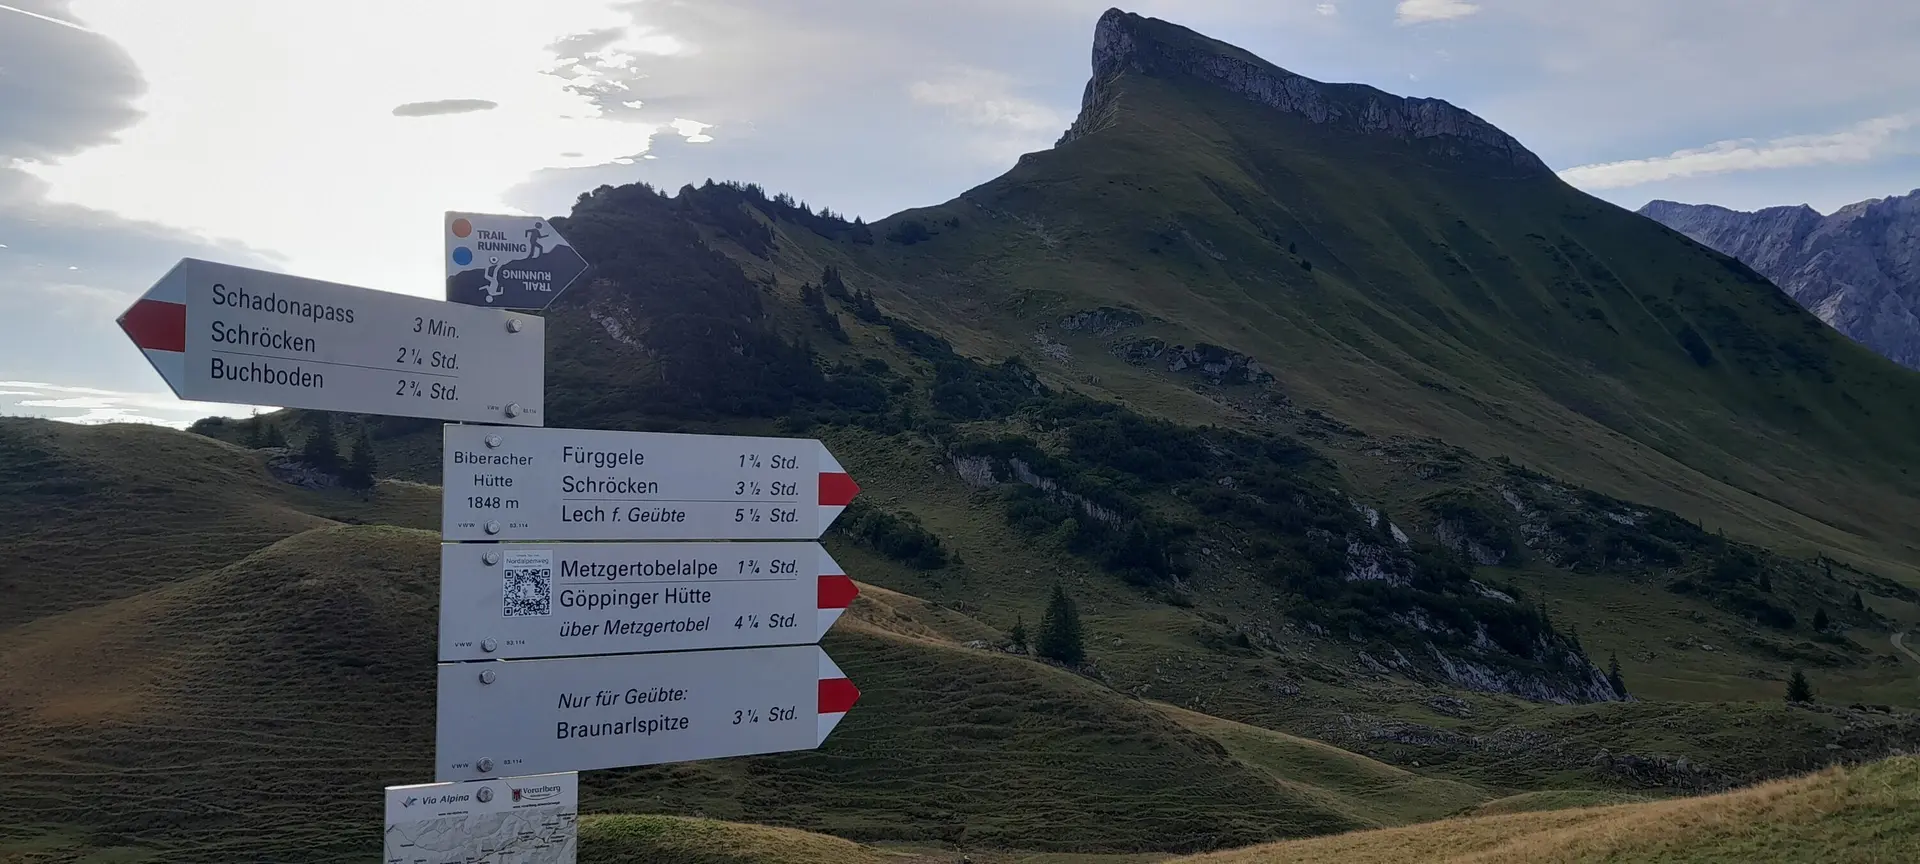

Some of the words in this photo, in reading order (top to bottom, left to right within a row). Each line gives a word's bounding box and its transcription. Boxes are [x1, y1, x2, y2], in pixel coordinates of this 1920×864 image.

[477, 230, 507, 241] TRAIL
[477, 242, 527, 253] RUNNING
[503, 269, 551, 281] RUNNING
[522, 281, 551, 292] TRAIL
[211, 283, 355, 325] Schadonapass
[413, 317, 425, 333] 3
[427, 318, 460, 339] Min.
[211, 320, 316, 353] Schröcken
[396, 347, 406, 364] 2
[430, 350, 460, 370] Std.
[211, 358, 324, 389] Buchboden
[396, 379, 405, 396] 2
[430, 382, 459, 401] Std.
[453, 451, 533, 466] Biberacher
[562, 447, 644, 470] Fürggele
[739, 455, 746, 468] 1
[770, 455, 800, 470] Std.
[473, 474, 513, 487] Hütte
[562, 476, 659, 495] Schröcken
[735, 482, 744, 496] 3
[769, 481, 799, 497] Std.
[467, 496, 501, 509] 1848
[505, 500, 519, 509] m
[562, 506, 605, 523] Lech
[611, 507, 622, 523] f.
[627, 507, 686, 523] Geübte
[735, 508, 744, 523] 5
[769, 508, 799, 523] Std.
[560, 559, 718, 579] Metzgertobelalpe
[737, 560, 744, 574] 1
[769, 559, 798, 575] Std.
[560, 588, 660, 610] Göppinger
[665, 588, 712, 605] Hütte
[559, 620, 598, 638] über
[602, 617, 710, 638] Metzgertobel
[734, 614, 744, 629] 4
[768, 613, 798, 628] Std.
[557, 692, 591, 710] Nur
[595, 690, 620, 707] für
[624, 687, 688, 705] Geübte:
[556, 716, 689, 740] Braunarlspitze
[732, 710, 743, 725] 3
[768, 706, 798, 723] Std.
[422, 796, 437, 805] Via
[440, 793, 469, 805] Alpina
[523, 785, 561, 795] Vorarlberg
